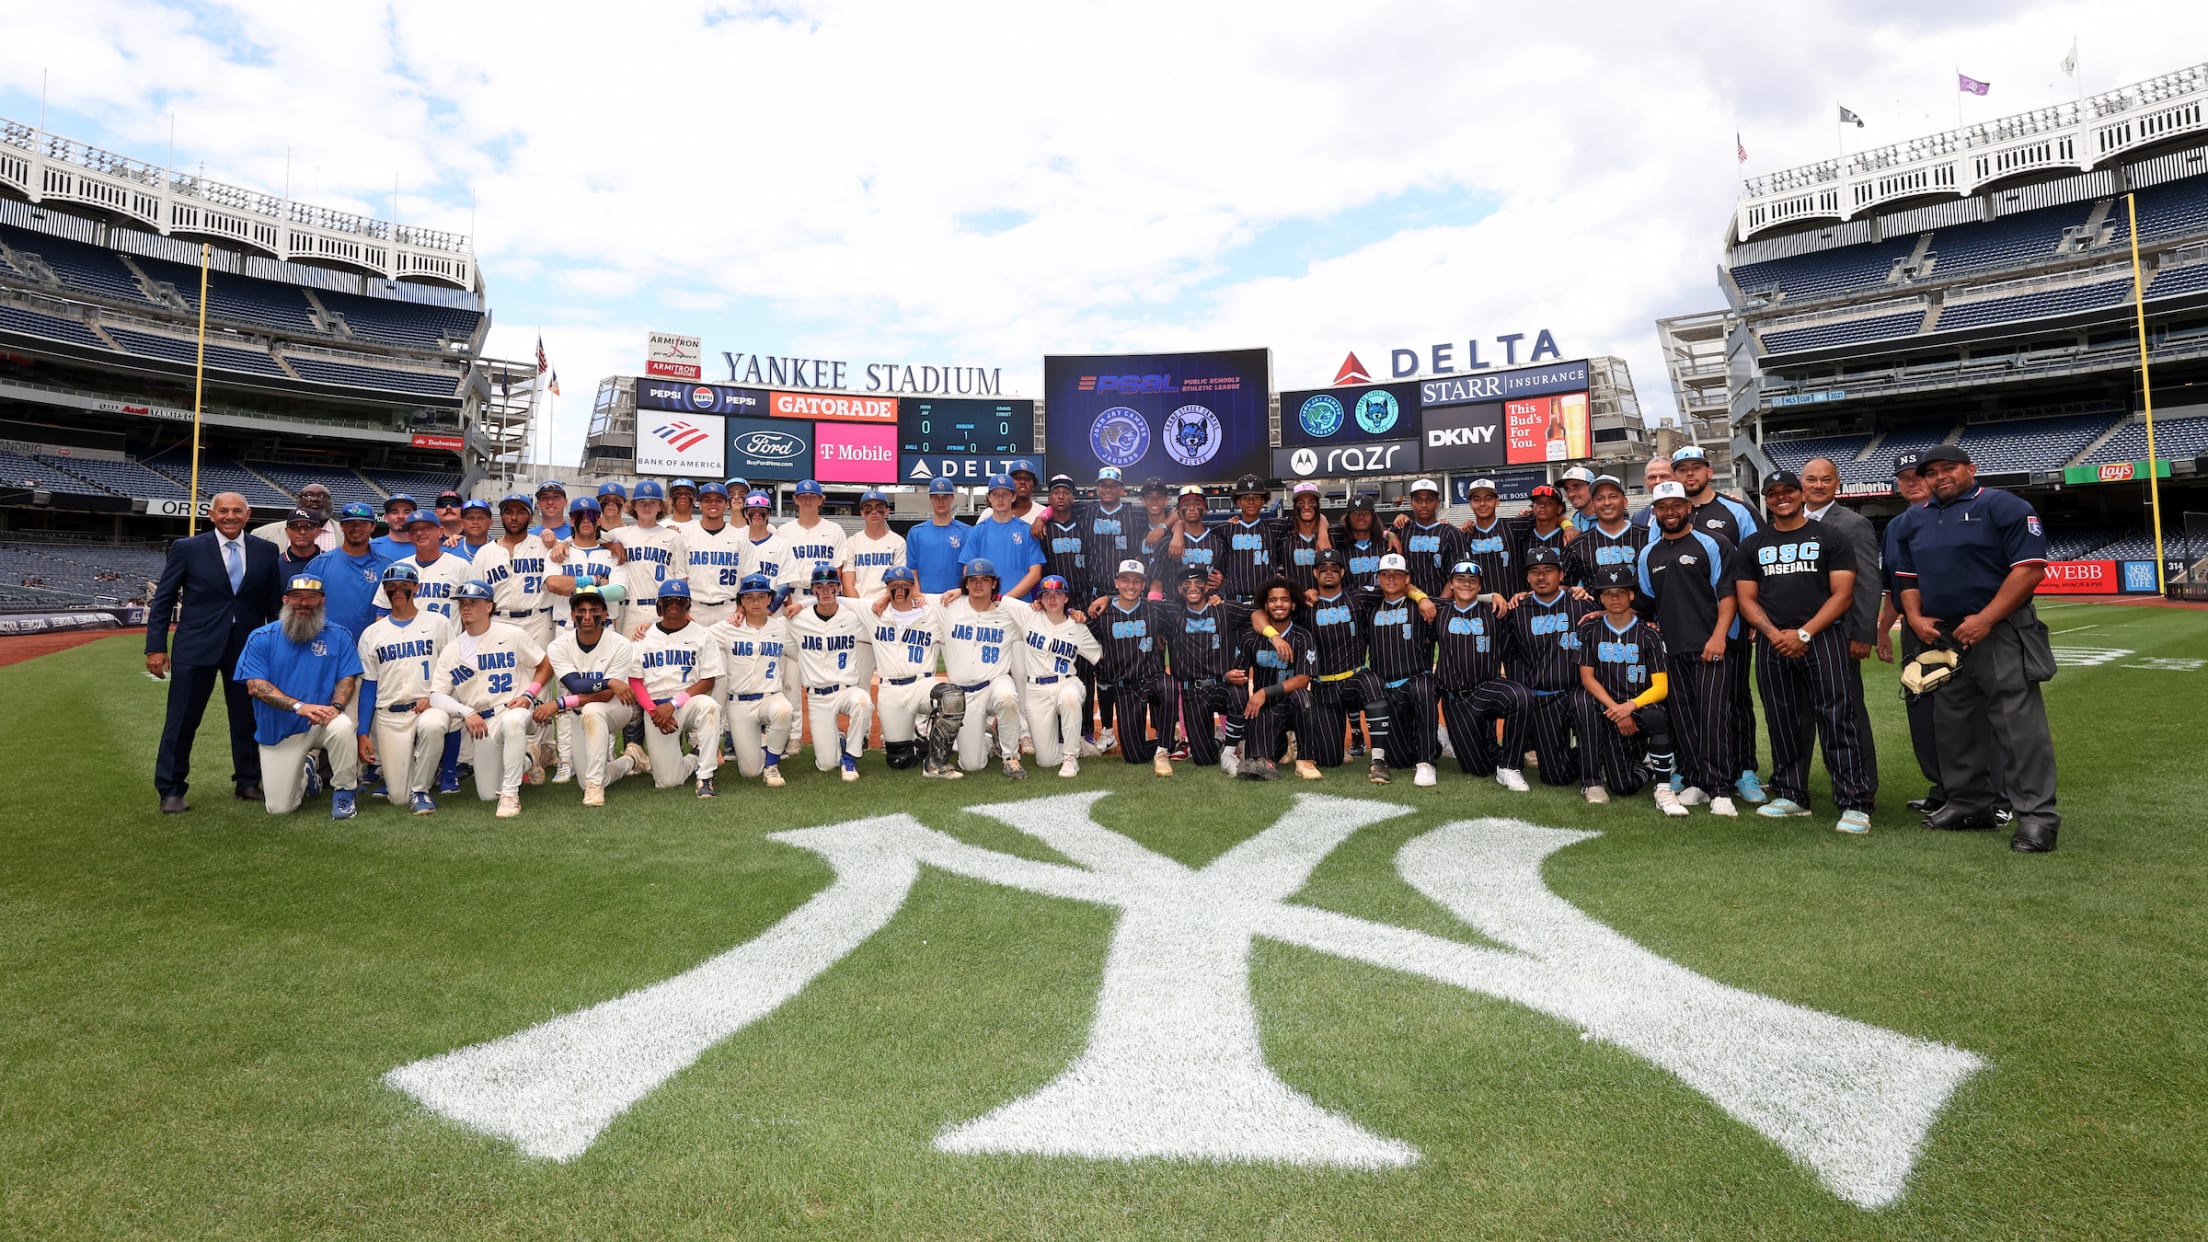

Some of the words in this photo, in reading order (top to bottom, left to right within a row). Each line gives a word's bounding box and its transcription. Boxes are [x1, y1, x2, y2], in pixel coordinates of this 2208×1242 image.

[1391, 329, 1562, 378] DELTA
[653, 364, 698, 375] ARMITRON
[722, 352, 847, 390] YANKEE
[866, 362, 1002, 396] STADIUM
[650, 388, 682, 400] PEPSI
[1423, 376, 1503, 403] STARR
[1510, 370, 1585, 389] INSURANCE
[122, 405, 149, 415] Audi
[726, 396, 756, 407] PEPSI
[778, 396, 893, 418] GATORADE
[1510, 403, 1537, 415] This
[921, 420, 931, 434] 0
[1000, 421, 1009, 435] 0
[1510, 413, 1543, 427] Bud's
[1428, 425, 1496, 447] DKNY
[1510, 427, 1531, 438] For
[747, 434, 793, 455] Ford
[840, 444, 892, 461] Mobile
[922, 442, 930, 452] 0
[970, 443, 977, 453] 0
[1009, 443, 1017, 453] 0
[1510, 438, 1537, 449] You.
[638, 457, 664, 466] BANK
[680, 460, 722, 470] AMERICA
[1327, 445, 1400, 473] razr
[942, 460, 1014, 478] DELT
[1510, 492, 1529, 500] BOSS
[1842, 482, 1893, 494] Authority
[162, 501, 211, 516] ORS
[1232, 533, 1263, 550] GSC
[1409, 535, 1441, 553] GSC
[689, 551, 740, 567] JAGUARS
[1293, 548, 1317, 566] GS
[1500, 551, 1509, 568] 7
[1595, 545, 1636, 566] GSC
[1758, 541, 1820, 565] GSC
[654, 564, 666, 582] 0
[1762, 561, 1818, 577] BASEBALL
[2044, 564, 2102, 580] WEBB
[2129, 564, 2150, 573] NEW
[2167, 561, 2184, 571] 314
[524, 576, 543, 594] 21
[719, 568, 738, 586] 26
[2127, 571, 2153, 582] YORK
[2131, 580, 2151, 588] LIFE
[1316, 605, 1352, 627] GSC
[1374, 607, 1409, 626] GSC
[1531, 612, 1569, 636] GSC
[951, 624, 1005, 643] JAGUARS
[1112, 619, 1147, 640] GSC
[1448, 617, 1484, 635] GSC
[801, 635, 855, 651] JAGUARS
[875, 626, 932, 647] JAGUARS
[1476, 636, 1490, 653] 51
[732, 641, 784, 658] JAGUARS
[907, 645, 925, 664] 10
[981, 645, 1000, 664] 88
[1598, 641, 1639, 663] GSC
[642, 649, 697, 669] JAGUARS
[838, 652, 848, 670] 8
[1053, 656, 1071, 674] 15
[421, 660, 430, 681] 1
[680, 666, 693, 683] 7
[765, 661, 776, 679] 2
[1627, 665, 1646, 683] 97
[488, 673, 513, 694] 32
